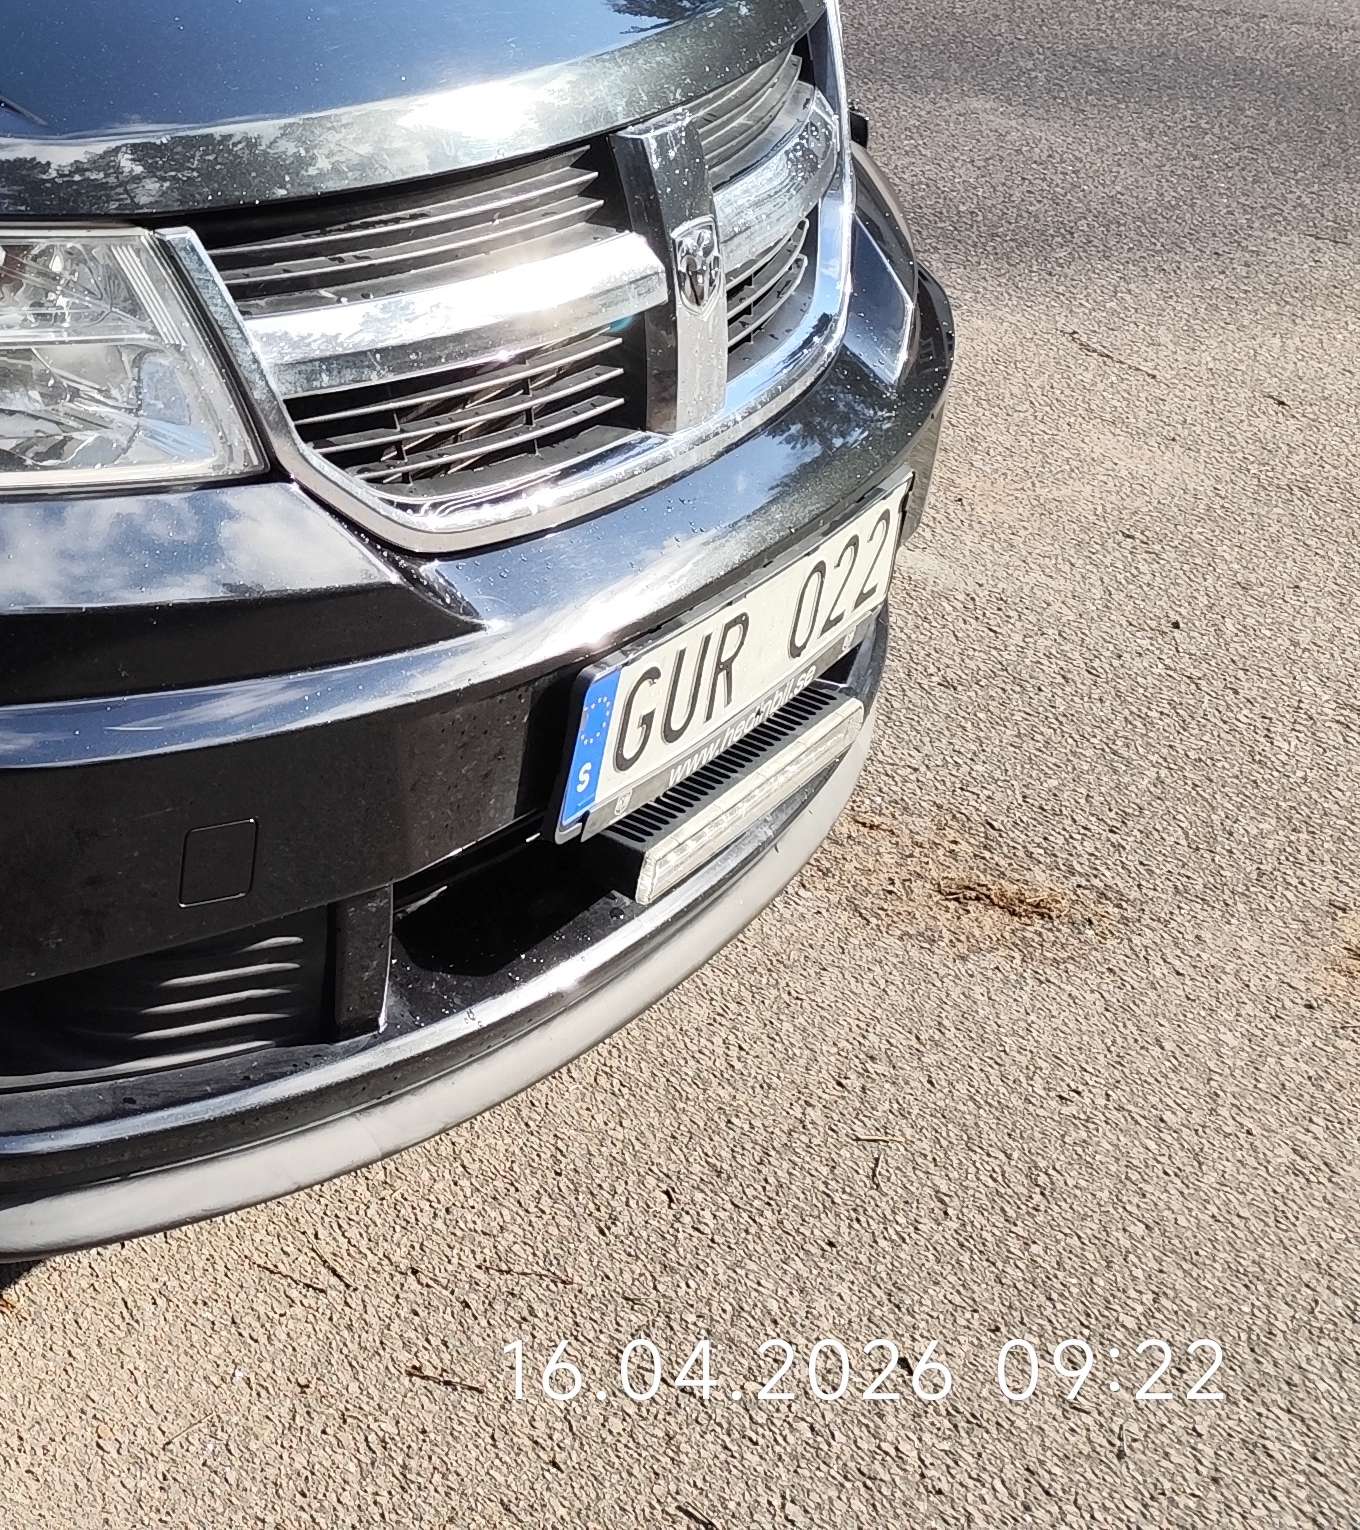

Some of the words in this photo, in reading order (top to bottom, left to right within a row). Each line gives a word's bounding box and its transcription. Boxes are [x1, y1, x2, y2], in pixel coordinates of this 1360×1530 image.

[613, 611, 750, 773] GUR
[787, 507, 891, 660] 022
[576, 761, 592, 793] S
